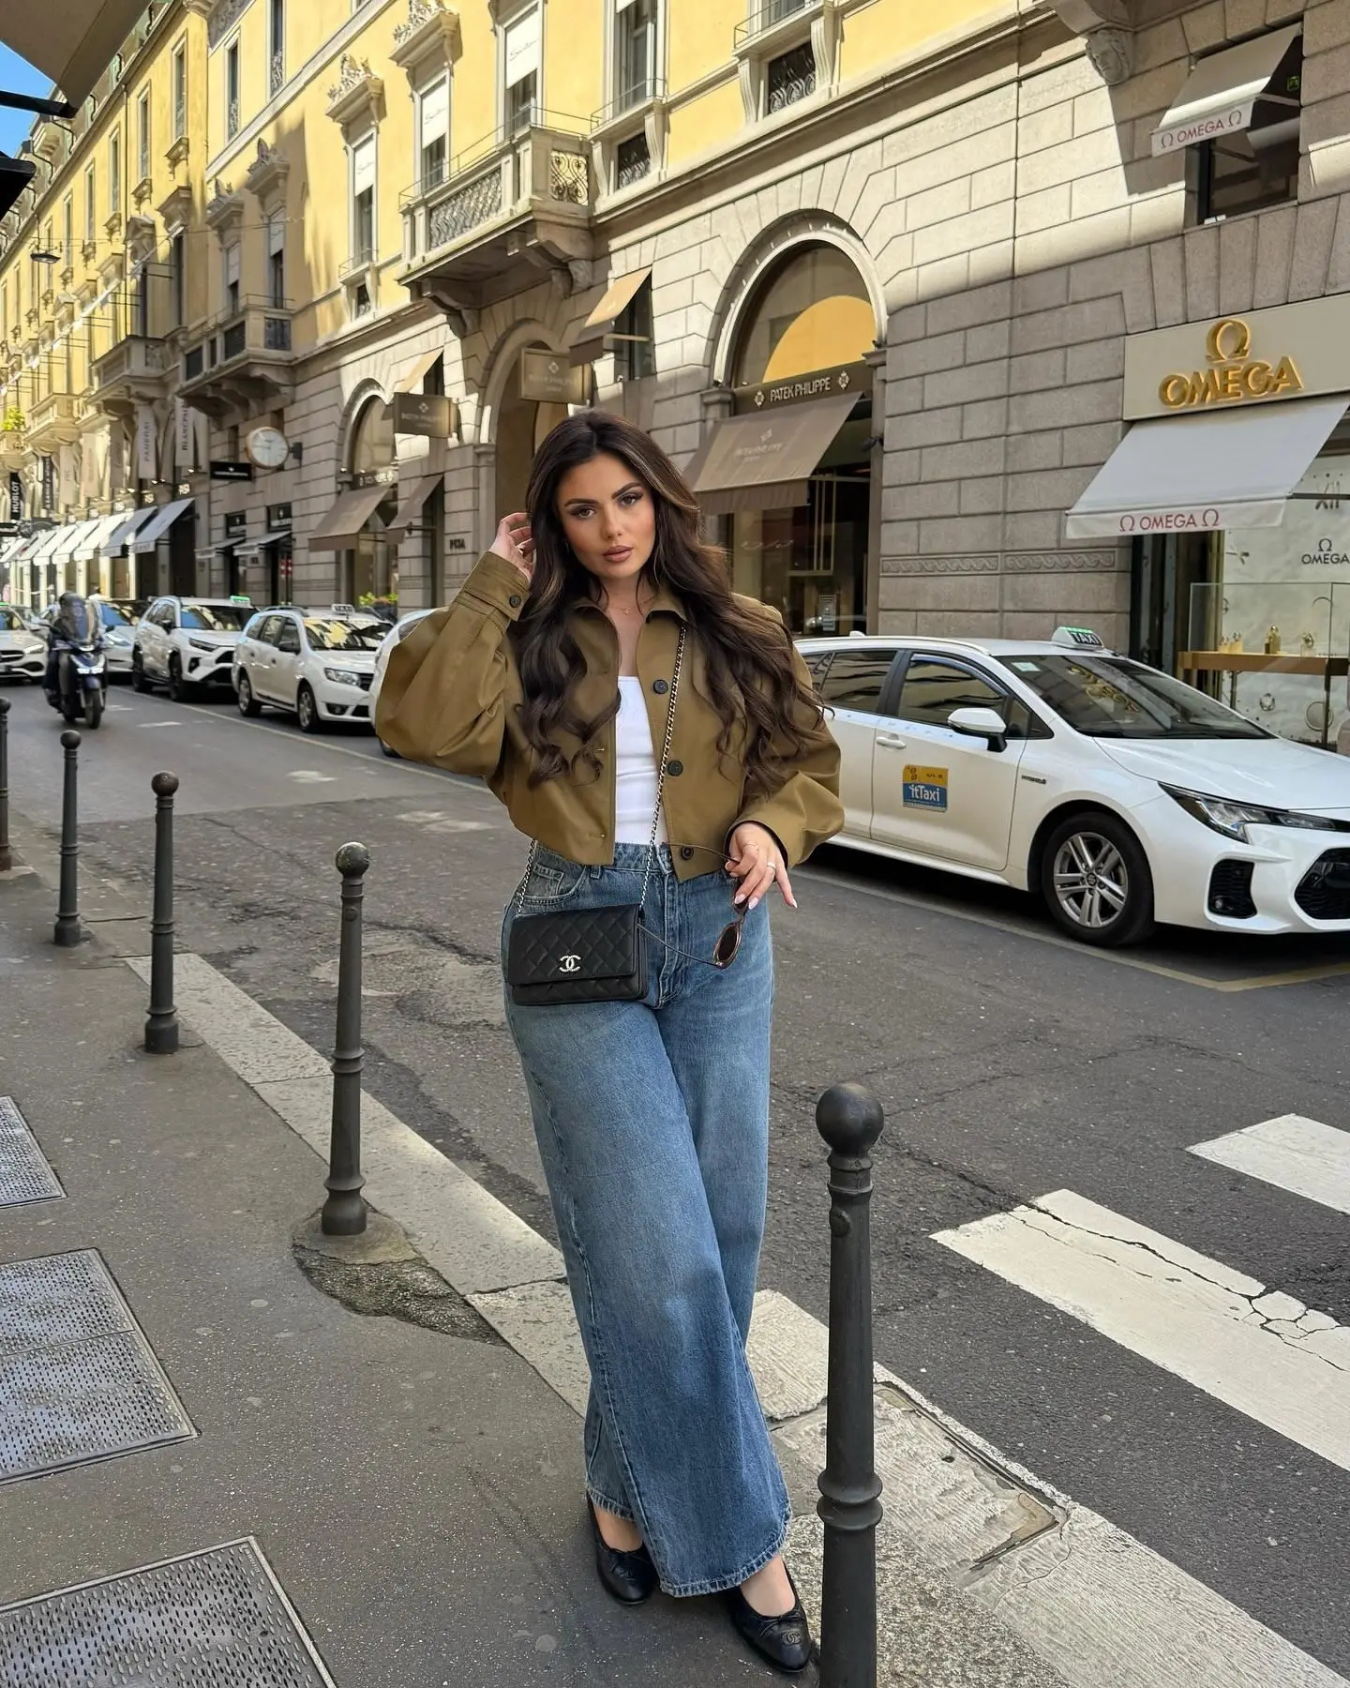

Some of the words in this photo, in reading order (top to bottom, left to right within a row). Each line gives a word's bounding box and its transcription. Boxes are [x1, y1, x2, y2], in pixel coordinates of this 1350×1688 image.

[1177, 120, 1225, 143] OMEGA
[770, 385, 795, 402] PATEK
[794, 377, 831, 397] PHILIPPE
[1158, 356, 1304, 408] OMEGA
[12, 481, 20, 513] HUBLOT
[1140, 514, 1197, 531] OMEGA
[1301, 553, 1350, 565] OMEGA
[1069, 631, 1102, 646] TAXI
